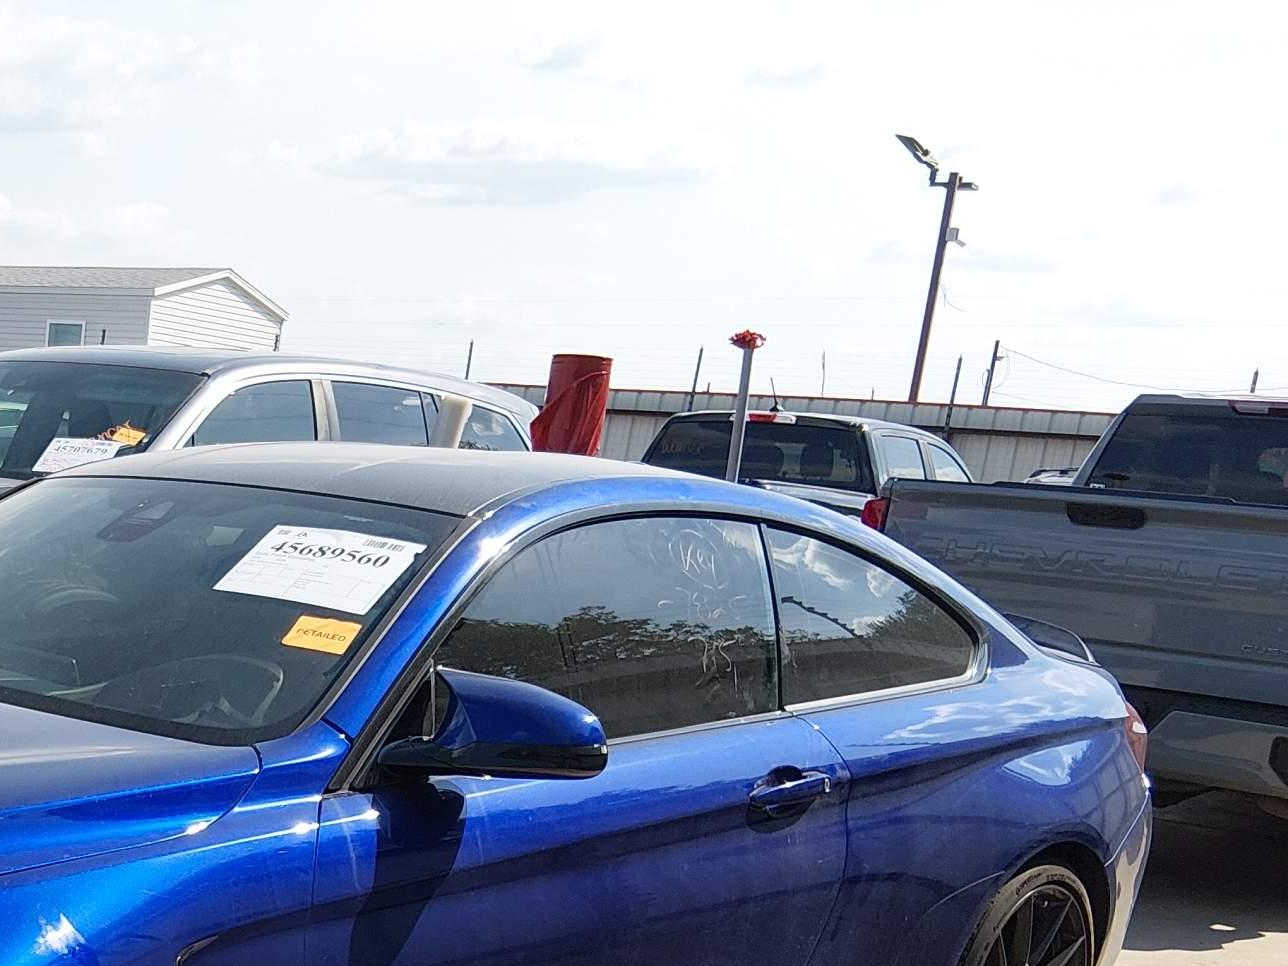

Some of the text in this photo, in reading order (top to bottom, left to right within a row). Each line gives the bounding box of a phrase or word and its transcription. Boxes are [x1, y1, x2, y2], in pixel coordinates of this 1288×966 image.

[55, 446, 108, 455] 45707679
[270, 541, 391, 568] 45689560
[296, 628, 347, 642] DETAILED
